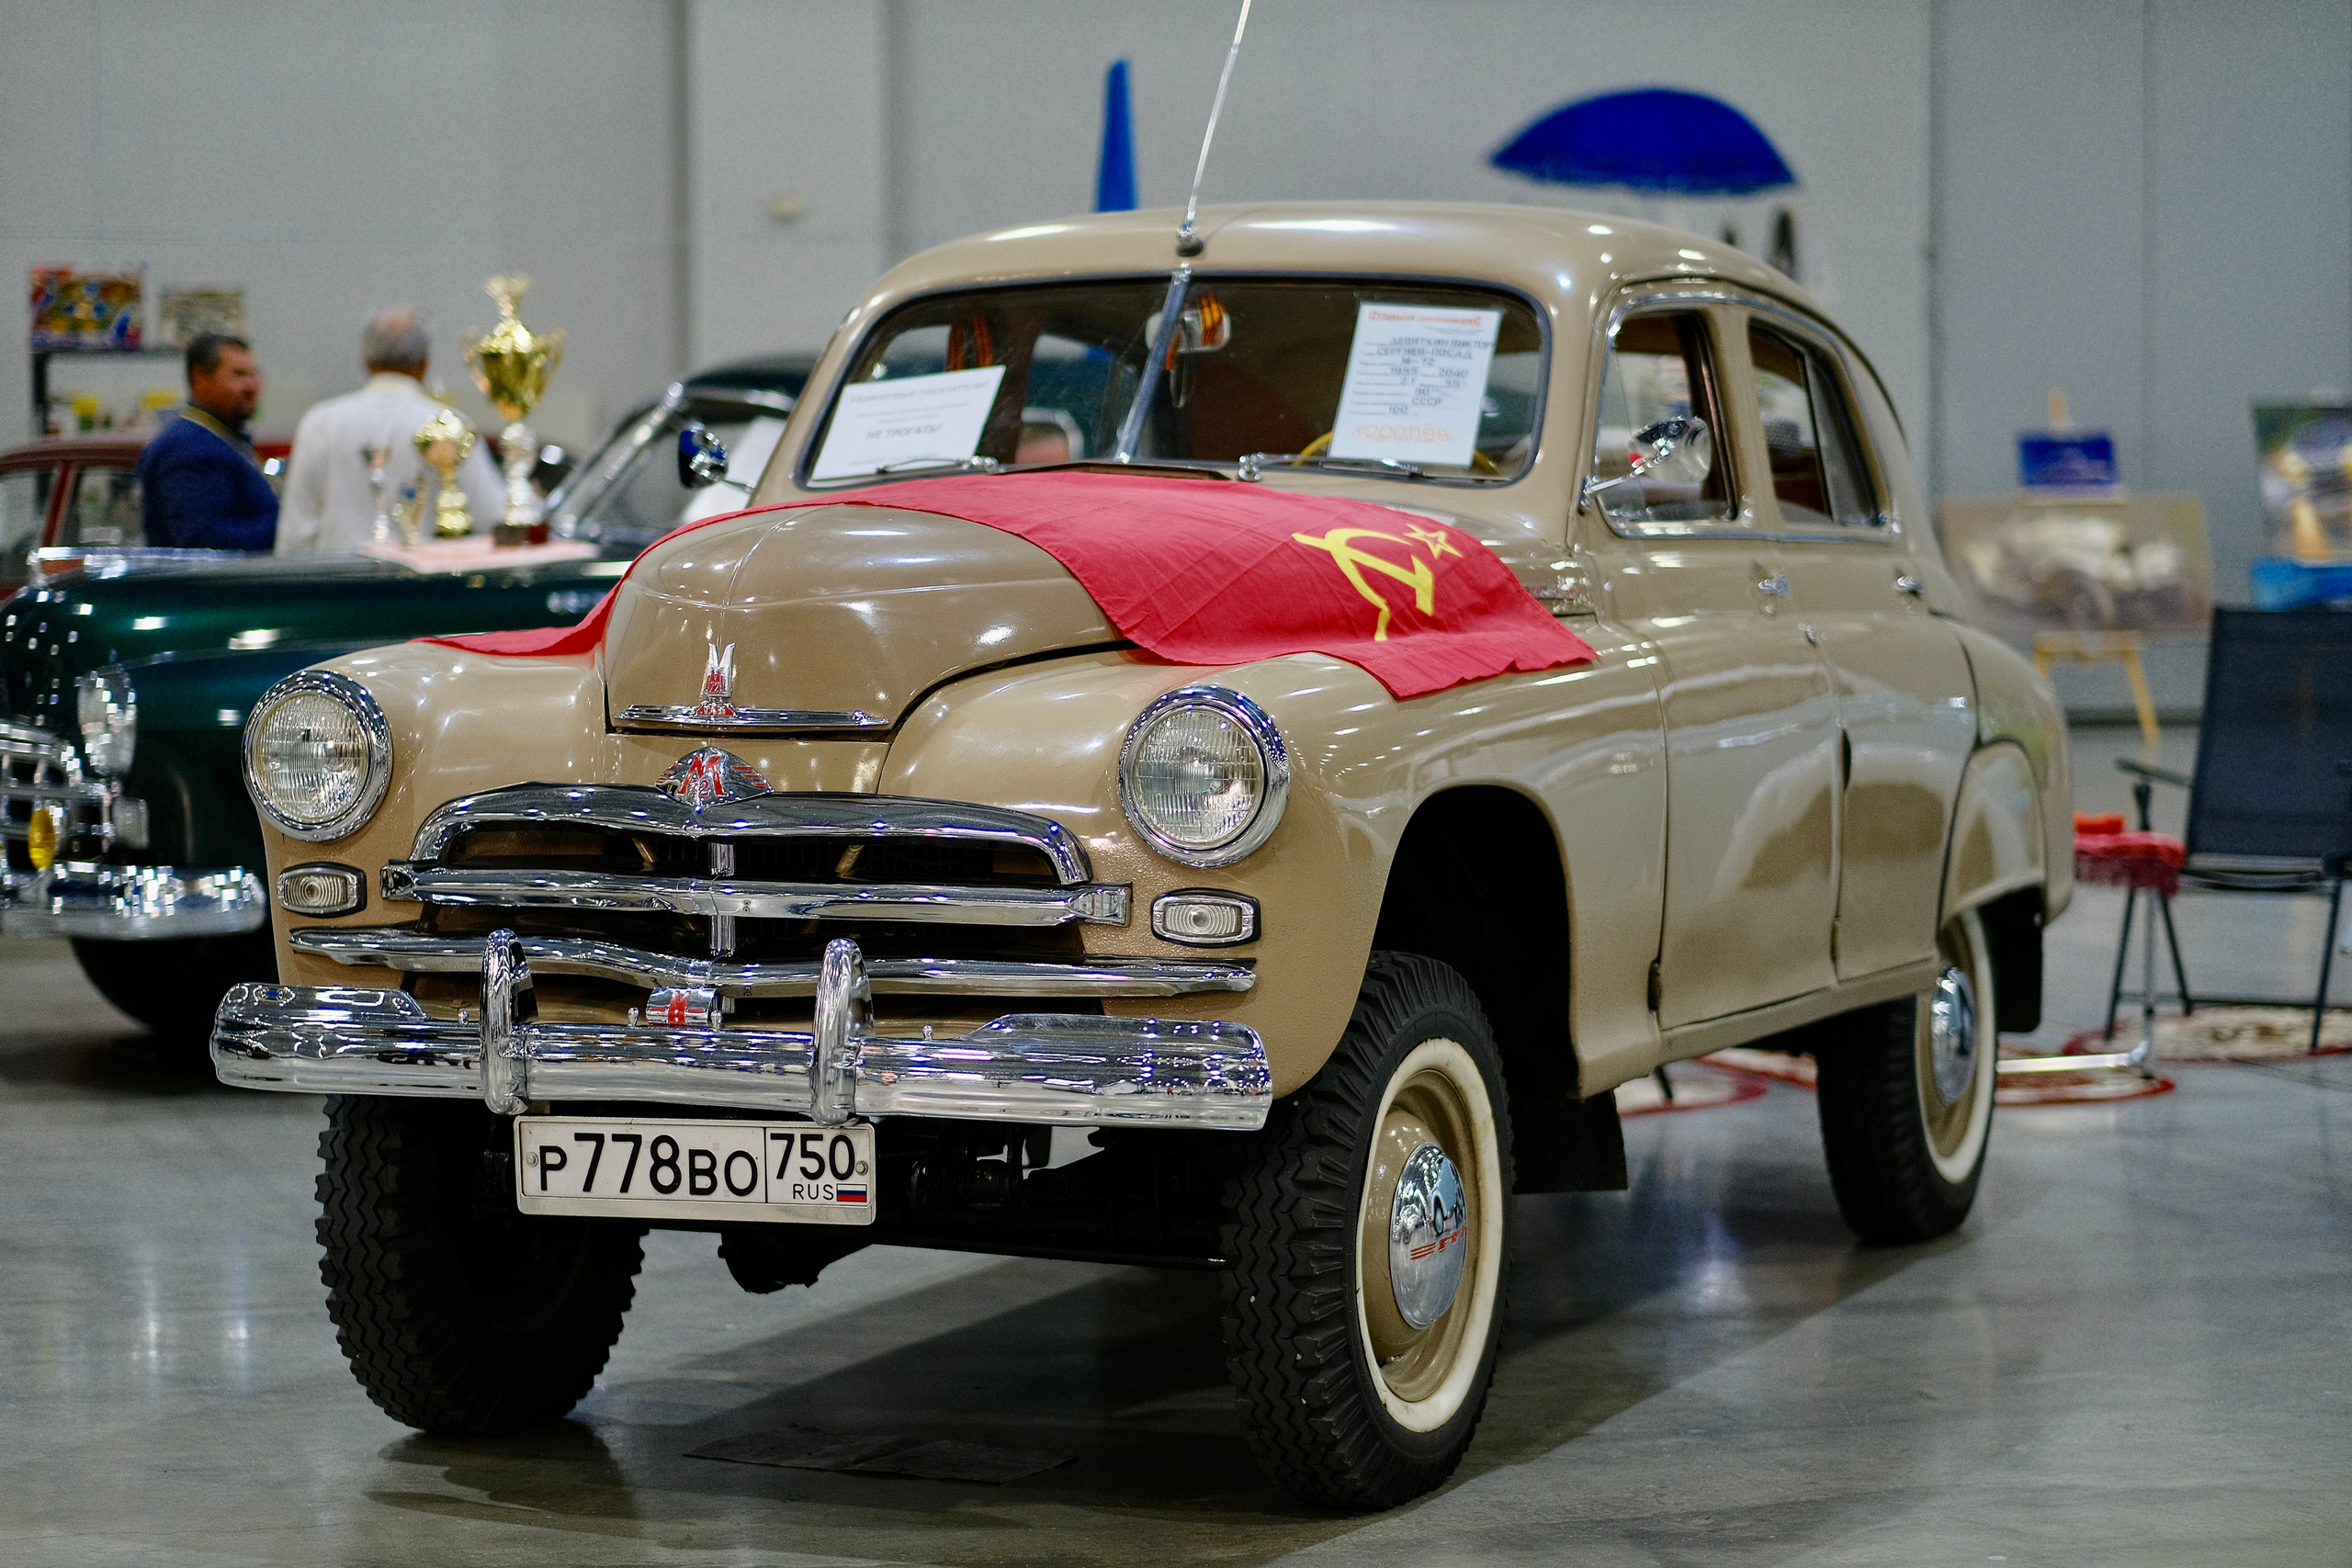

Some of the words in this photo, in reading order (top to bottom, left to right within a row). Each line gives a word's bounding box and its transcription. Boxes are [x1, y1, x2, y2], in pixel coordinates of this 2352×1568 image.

[1411, 397, 1442, 406] СССР
[770, 1133, 856, 1181] 750
[792, 1183, 835, 1201] RUS
